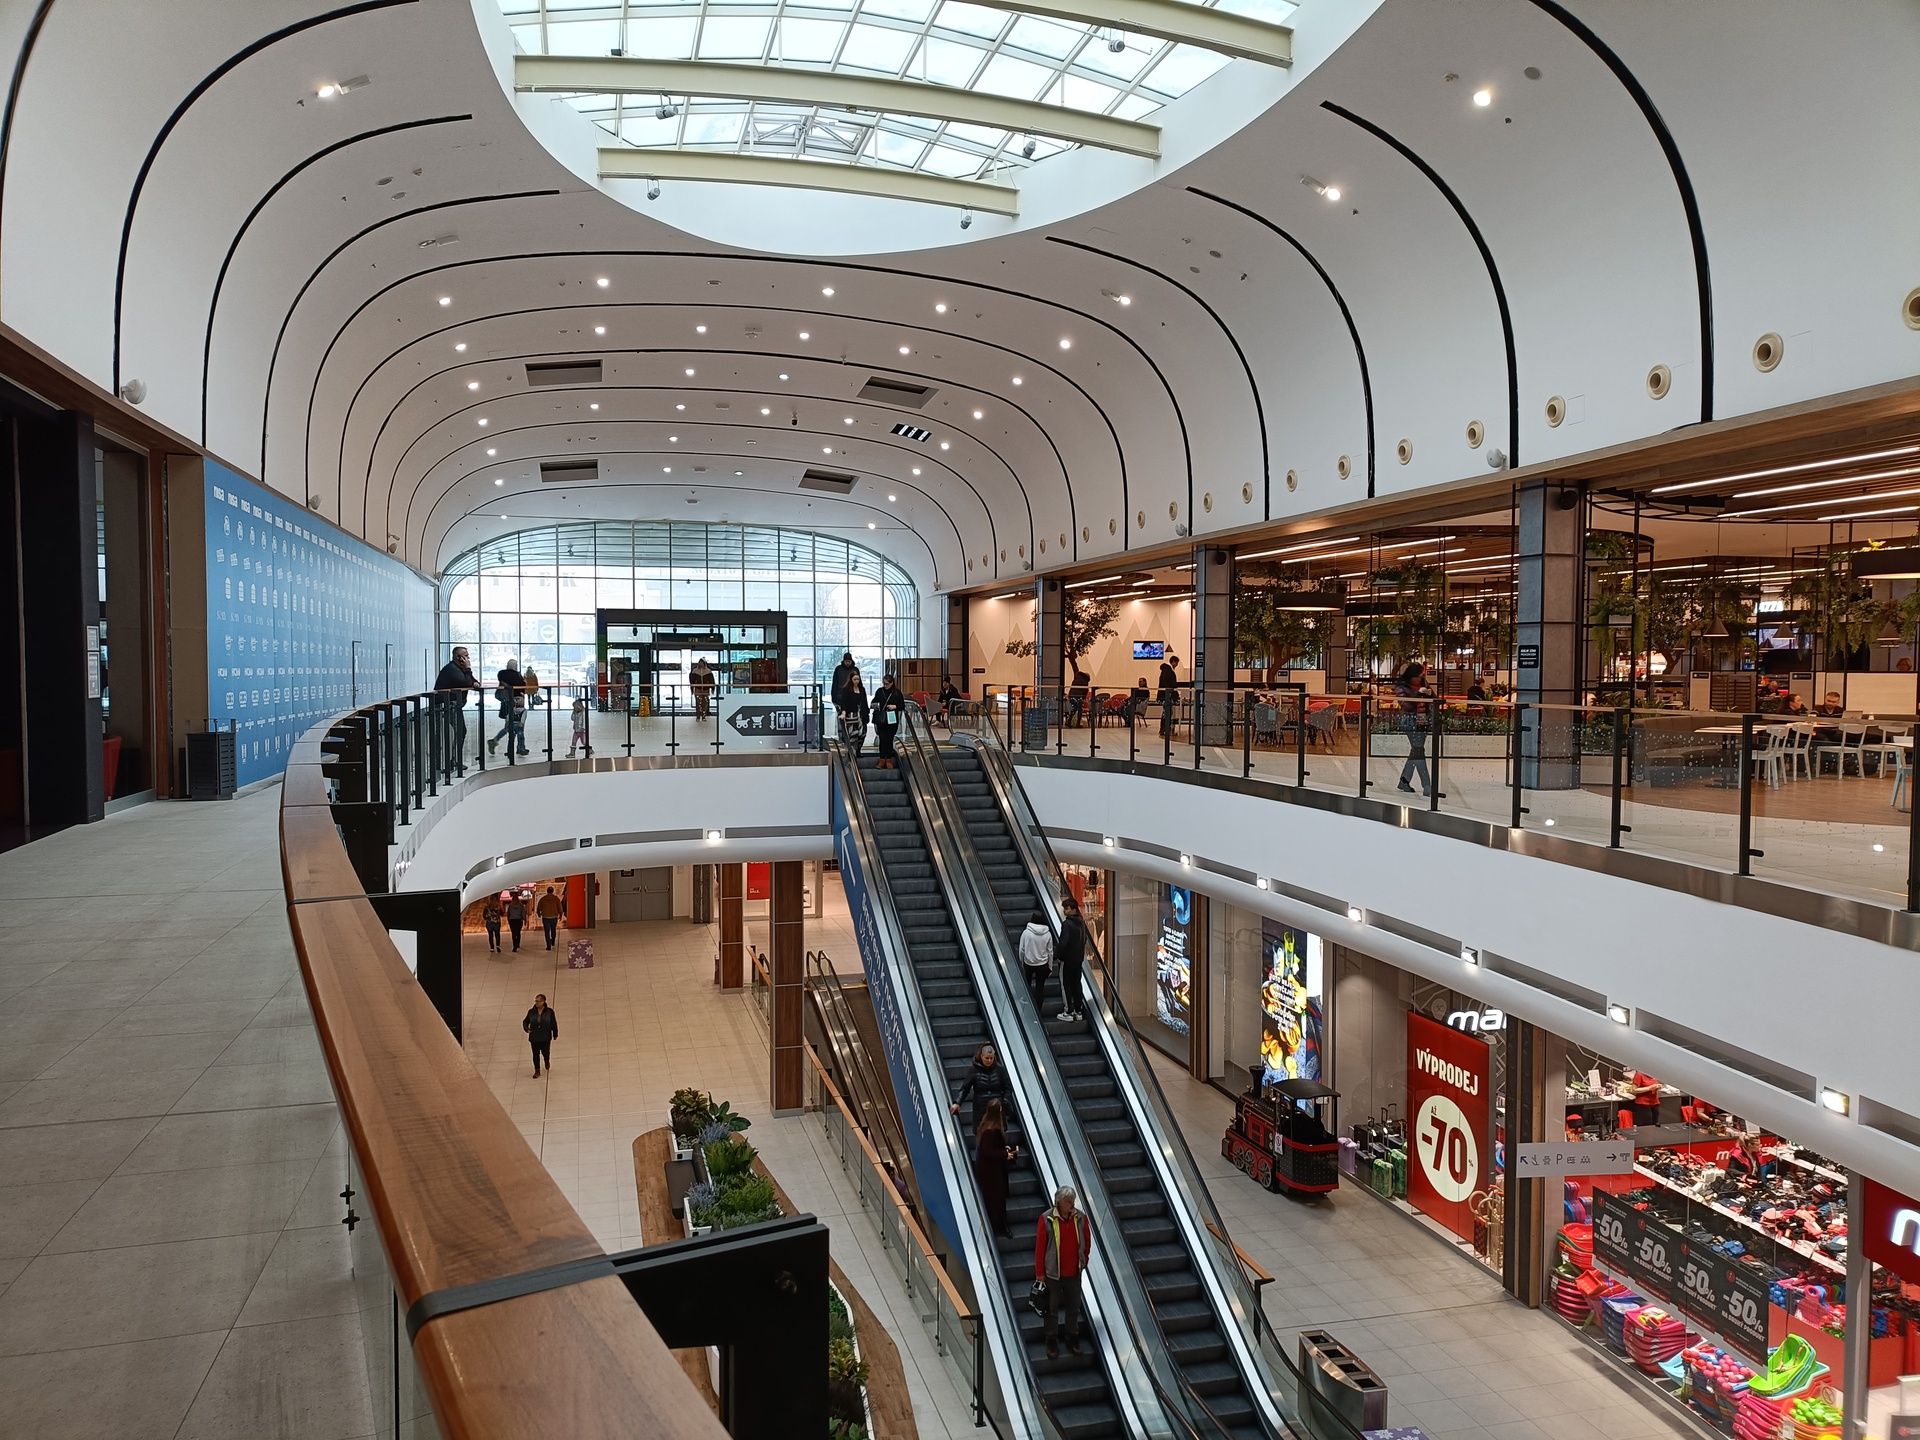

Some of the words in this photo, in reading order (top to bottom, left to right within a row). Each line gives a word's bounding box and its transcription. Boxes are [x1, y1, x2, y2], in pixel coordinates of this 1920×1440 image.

[884, 982, 902, 1051] novým
[902, 1050, 924, 1139] chutím.
[1416, 1048, 1479, 1096] VÝPRODEJ
[1422, 1115, 1467, 1185] -70
